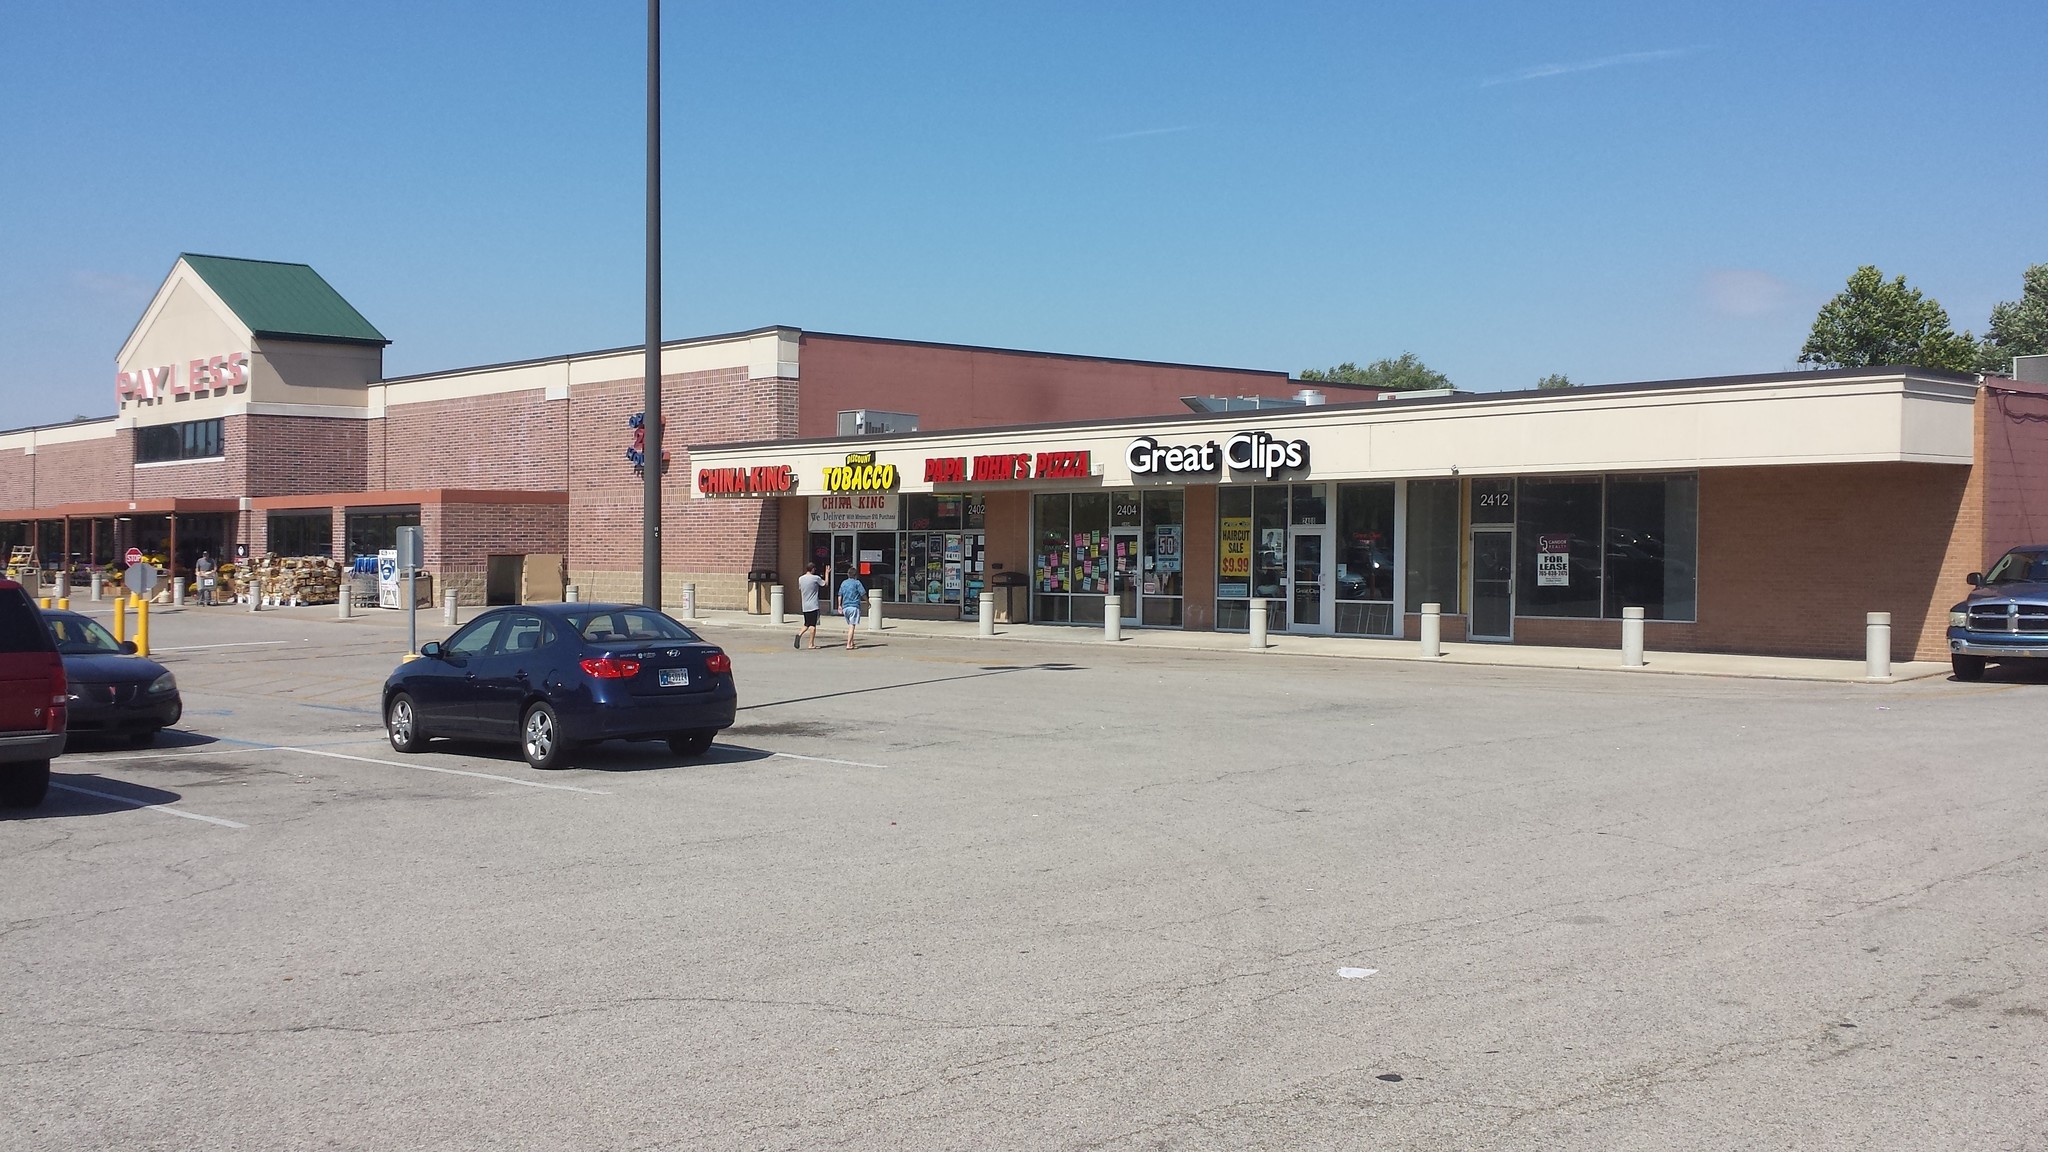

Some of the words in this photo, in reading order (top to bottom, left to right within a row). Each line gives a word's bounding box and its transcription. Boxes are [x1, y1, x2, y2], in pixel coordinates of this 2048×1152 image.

[115, 352, 248, 403] PAYLESS
[847, 453, 872, 464] DISCOUNT
[1125, 438, 1217, 474] Great
[1223, 432, 1305, 478] Clips
[924, 457, 967, 482] PAPA
[971, 453, 1032, 481] JOHN'S
[1034, 450, 1091, 479] PIZZA
[698, 468, 747, 493] CHINA
[750, 465, 793, 492] KING
[822, 464, 895, 491] TOBACCO
[822, 497, 852, 510] CHINA
[858, 496, 885, 509] KING
[1480, 494, 1509, 506] 2412
[968, 505, 985, 515] 2402
[1116, 505, 1137, 516] 2404
[823, 512, 845, 521] Deliver
[1222, 530, 1250, 541] HAIRCUT
[1228, 543, 1244, 553] SALE
[127, 554, 140, 562] STOP
[1222, 557, 1249, 573] $9.99
[1539, 563, 1568, 571] LEASE
